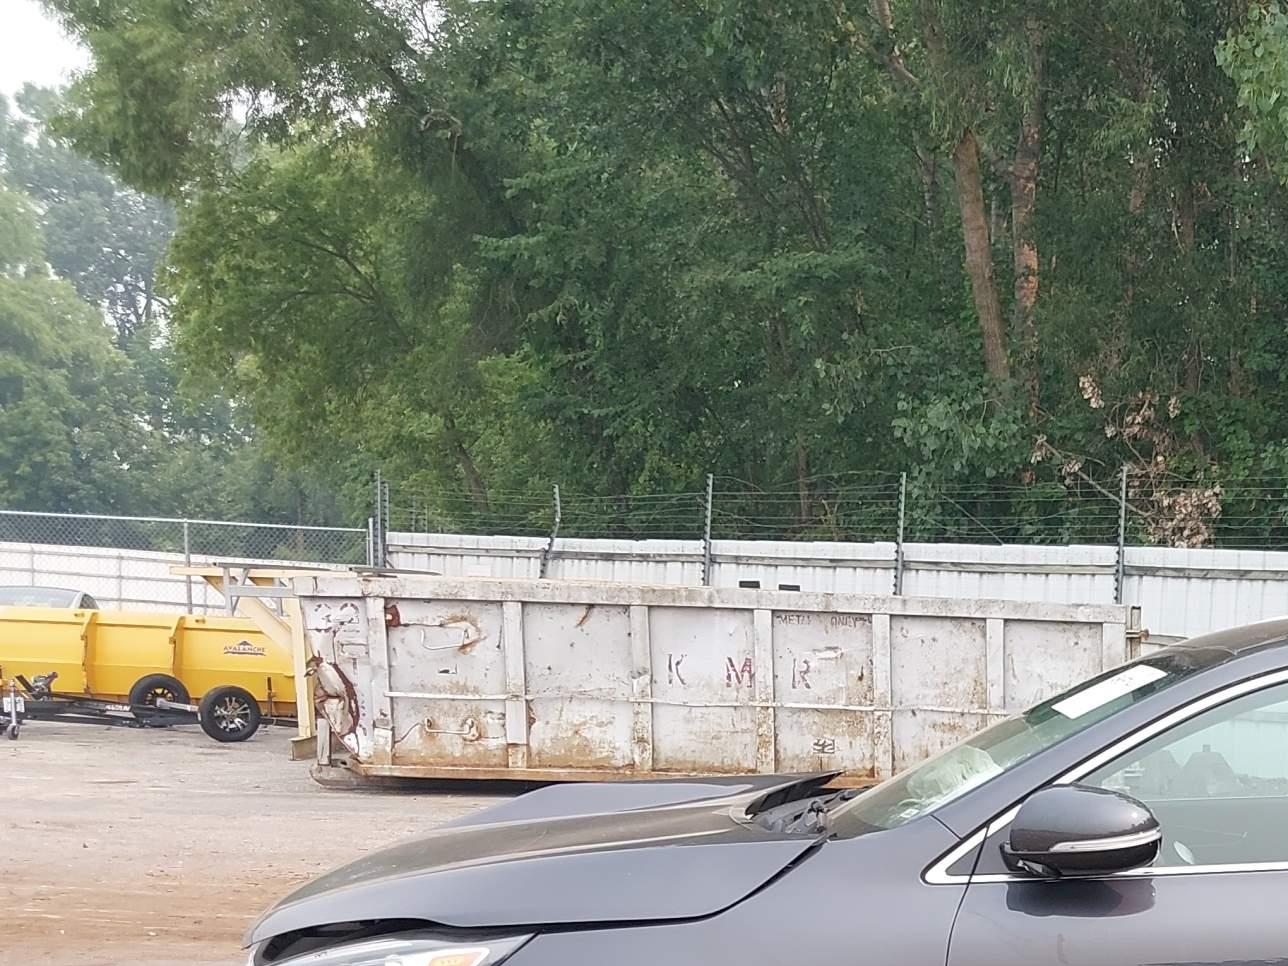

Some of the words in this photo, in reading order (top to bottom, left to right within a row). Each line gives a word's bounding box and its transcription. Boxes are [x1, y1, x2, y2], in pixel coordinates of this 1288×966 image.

[668, 653, 687, 686] K
[726, 656, 754, 688] M
[792, 657, 811, 689] R
